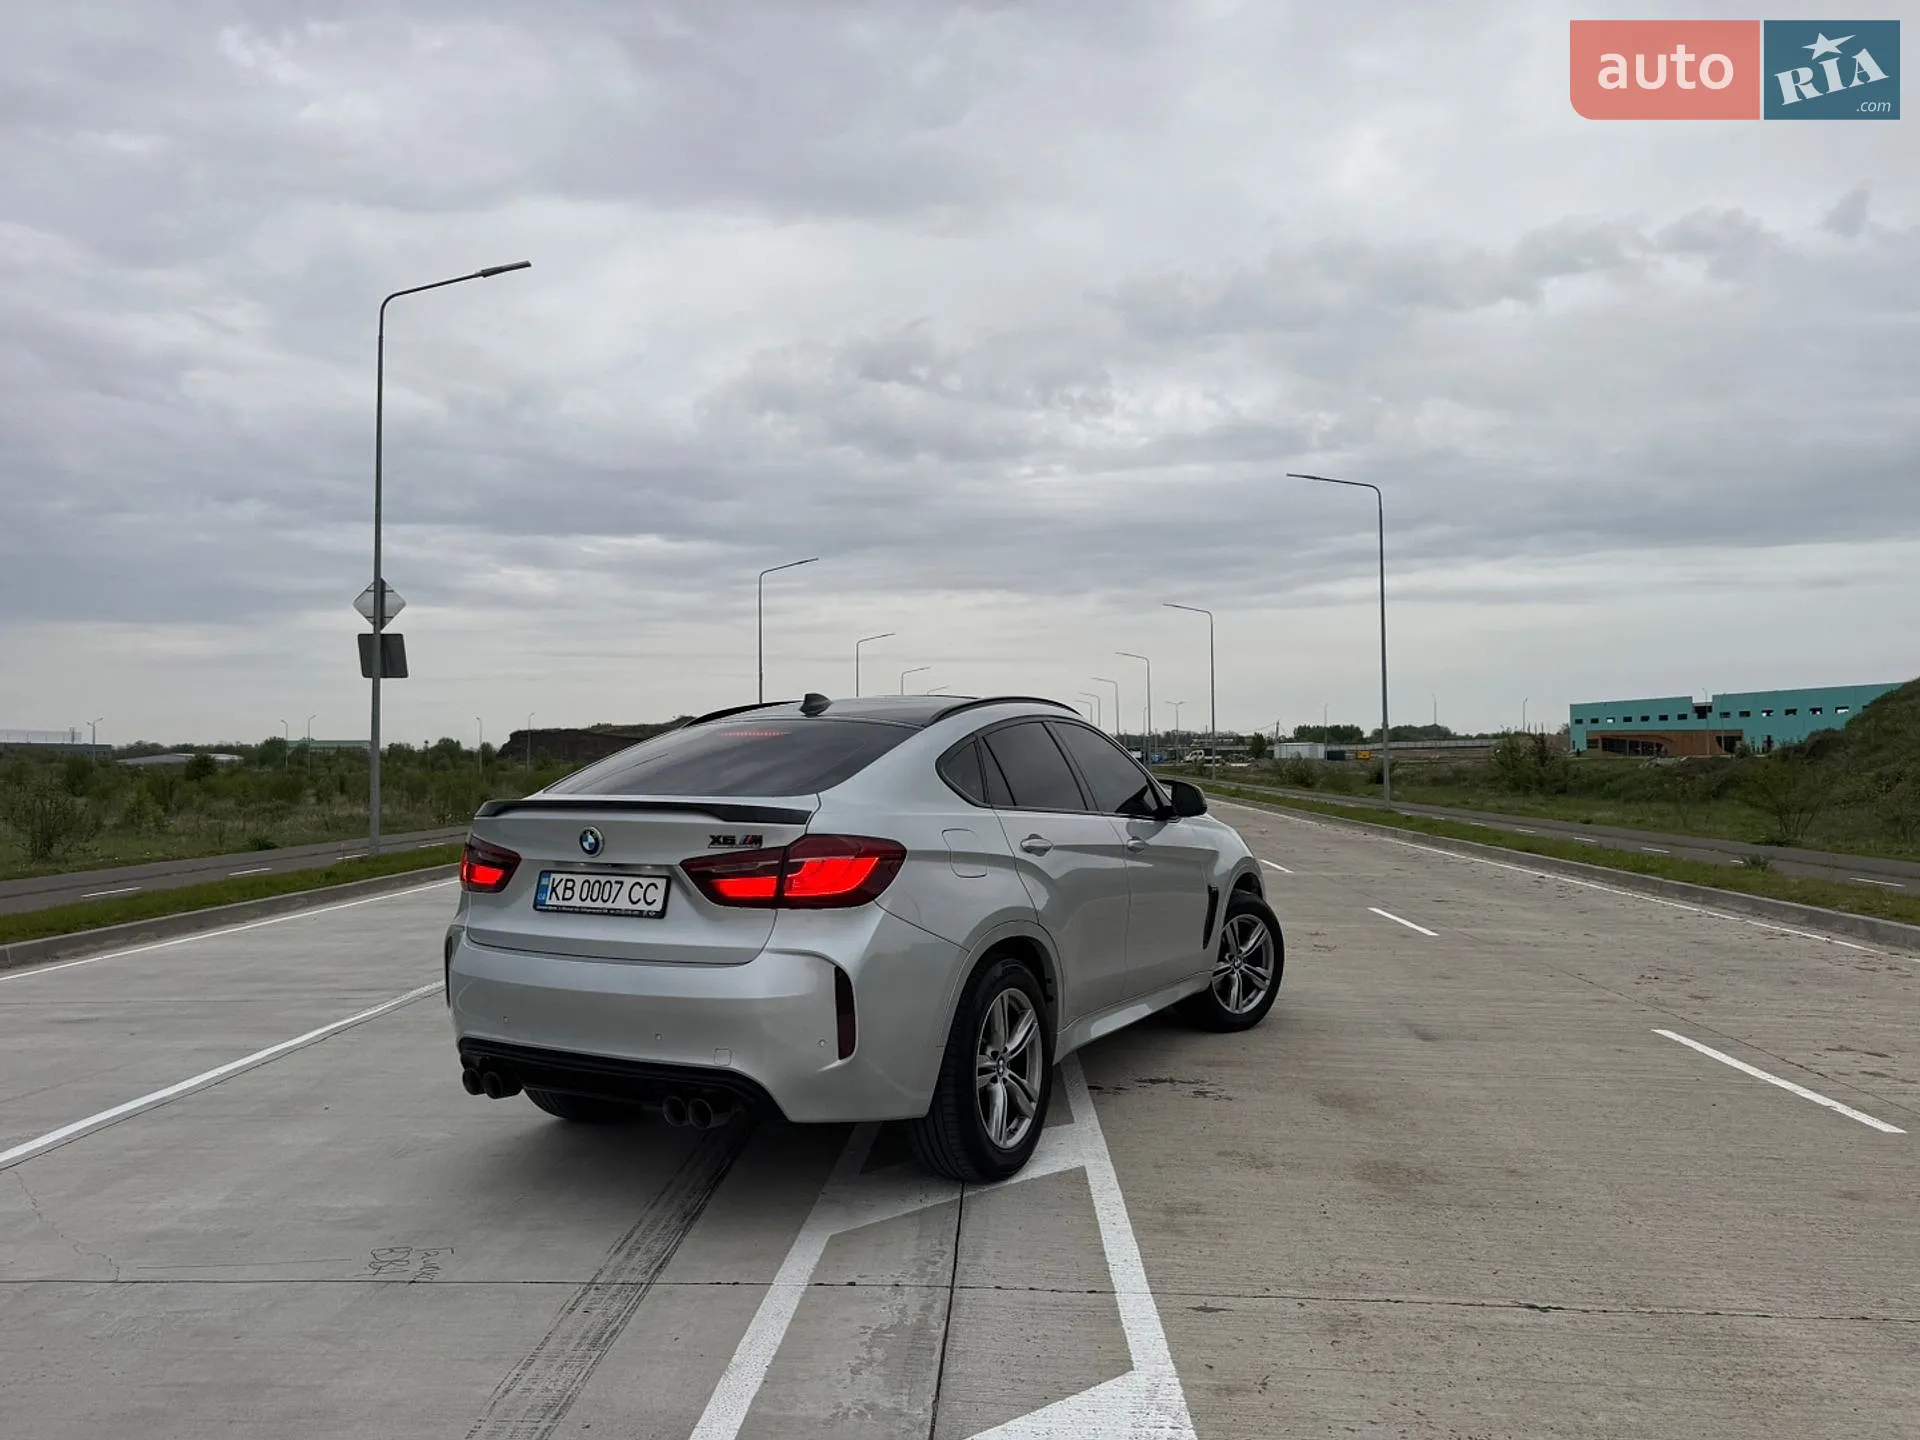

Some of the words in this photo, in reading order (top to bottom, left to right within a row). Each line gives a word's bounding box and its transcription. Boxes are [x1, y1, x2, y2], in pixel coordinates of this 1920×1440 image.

[549, 878, 576, 901] KB
[579, 879, 624, 904] 0007
[628, 882, 658, 906] CC
